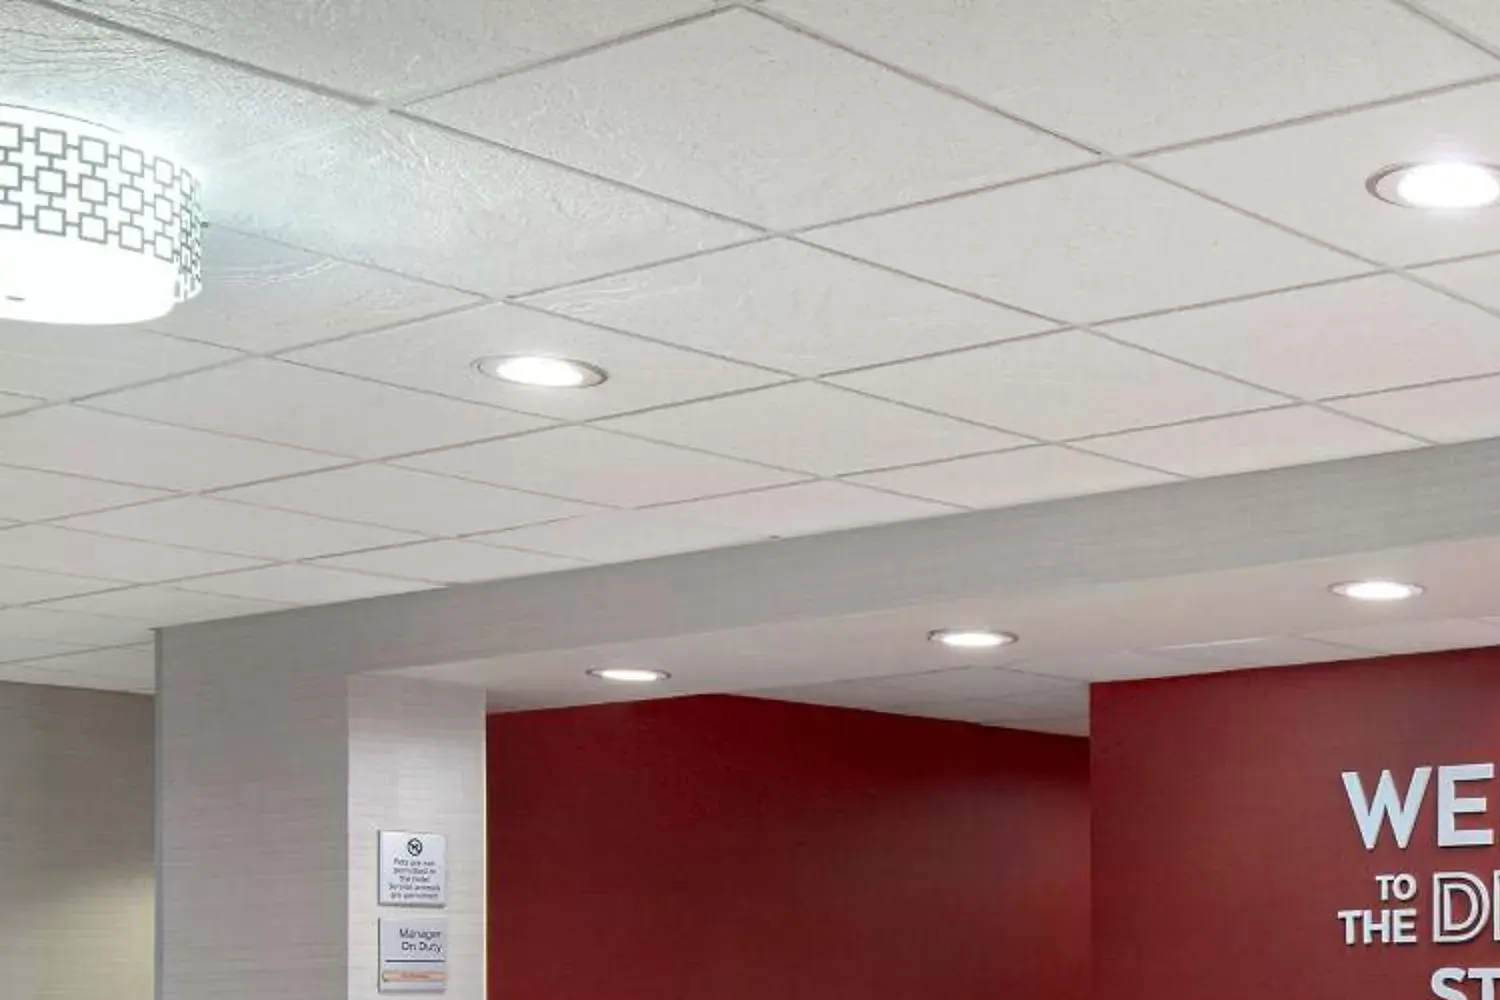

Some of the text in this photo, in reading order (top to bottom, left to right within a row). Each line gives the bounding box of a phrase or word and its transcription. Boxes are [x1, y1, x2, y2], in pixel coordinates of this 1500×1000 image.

[1375, 873, 1418, 902] TO
[399, 928, 442, 941] Manager
[1337, 908, 1418, 944] THE
[401, 941, 443, 953] On Duty
